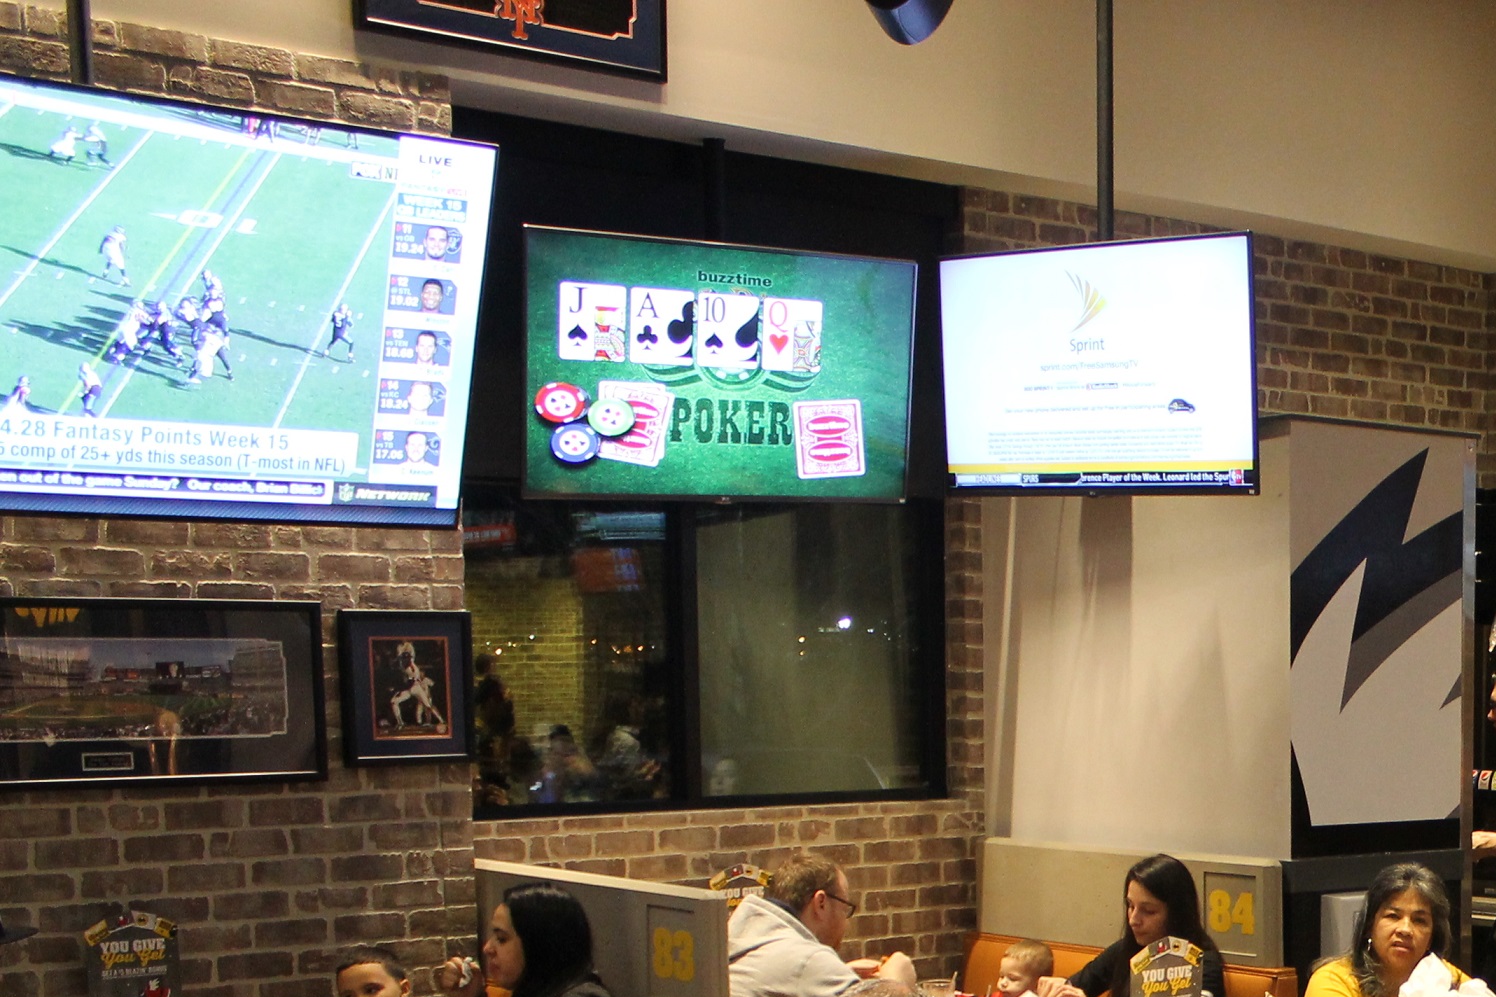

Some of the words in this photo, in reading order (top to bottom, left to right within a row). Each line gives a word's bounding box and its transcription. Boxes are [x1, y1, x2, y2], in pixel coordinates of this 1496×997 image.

[418, 154, 453, 167] LIVE
[395, 242, 424, 254] 19.24
[697, 270, 772, 288] buzztime
[390, 295, 419, 307] 19.02
[568, 286, 589, 313] J
[636, 291, 660, 319] A
[703, 296, 726, 323] 10
[768, 301, 788, 333] Q
[1069, 338, 1105, 354] Sprint
[668, 397, 793, 447] POKER
[0, 418, 46, 437] 4.28
[54, 421, 133, 446] Fantasy
[142, 427, 201, 446] Points
[209, 430, 260, 449] Week
[269, 434, 289, 451] 15
[11, 444, 55, 461] comp
[61, 445, 76, 459] of
[81, 446, 110, 461] 25+
[117, 448, 142, 465] yds
[148, 448, 175, 464] this
[180, 453, 232, 467] season
[237, 453, 293, 470] (T-most
[298, 456, 309, 470] in
[314, 457, 345, 475] NFL)
[1022, 473, 1039, 484] SPURS
[1103, 471, 1123, 483] Player
[1124, 472, 1130, 481] of
[1131, 471, 1141, 481] the
[1143, 471, 1162, 481] Week.
[1163, 471, 1190, 481] Leonard
[1191, 471, 1200, 480] led
[1202, 471, 1213, 480] the
[355, 488, 431, 502] NETWORK
[1208, 888, 1255, 935] 84
[100, 940, 130, 954] YOU
[132, 938, 167, 953] GIVE
[653, 926, 695, 983] 83
[101, 952, 135, 970] You
[136, 949, 166, 967] Get
[1142, 968, 1166, 983] YOU
[1167, 964, 1193, 980] GIVE
[1169, 977, 1192, 995] Get
